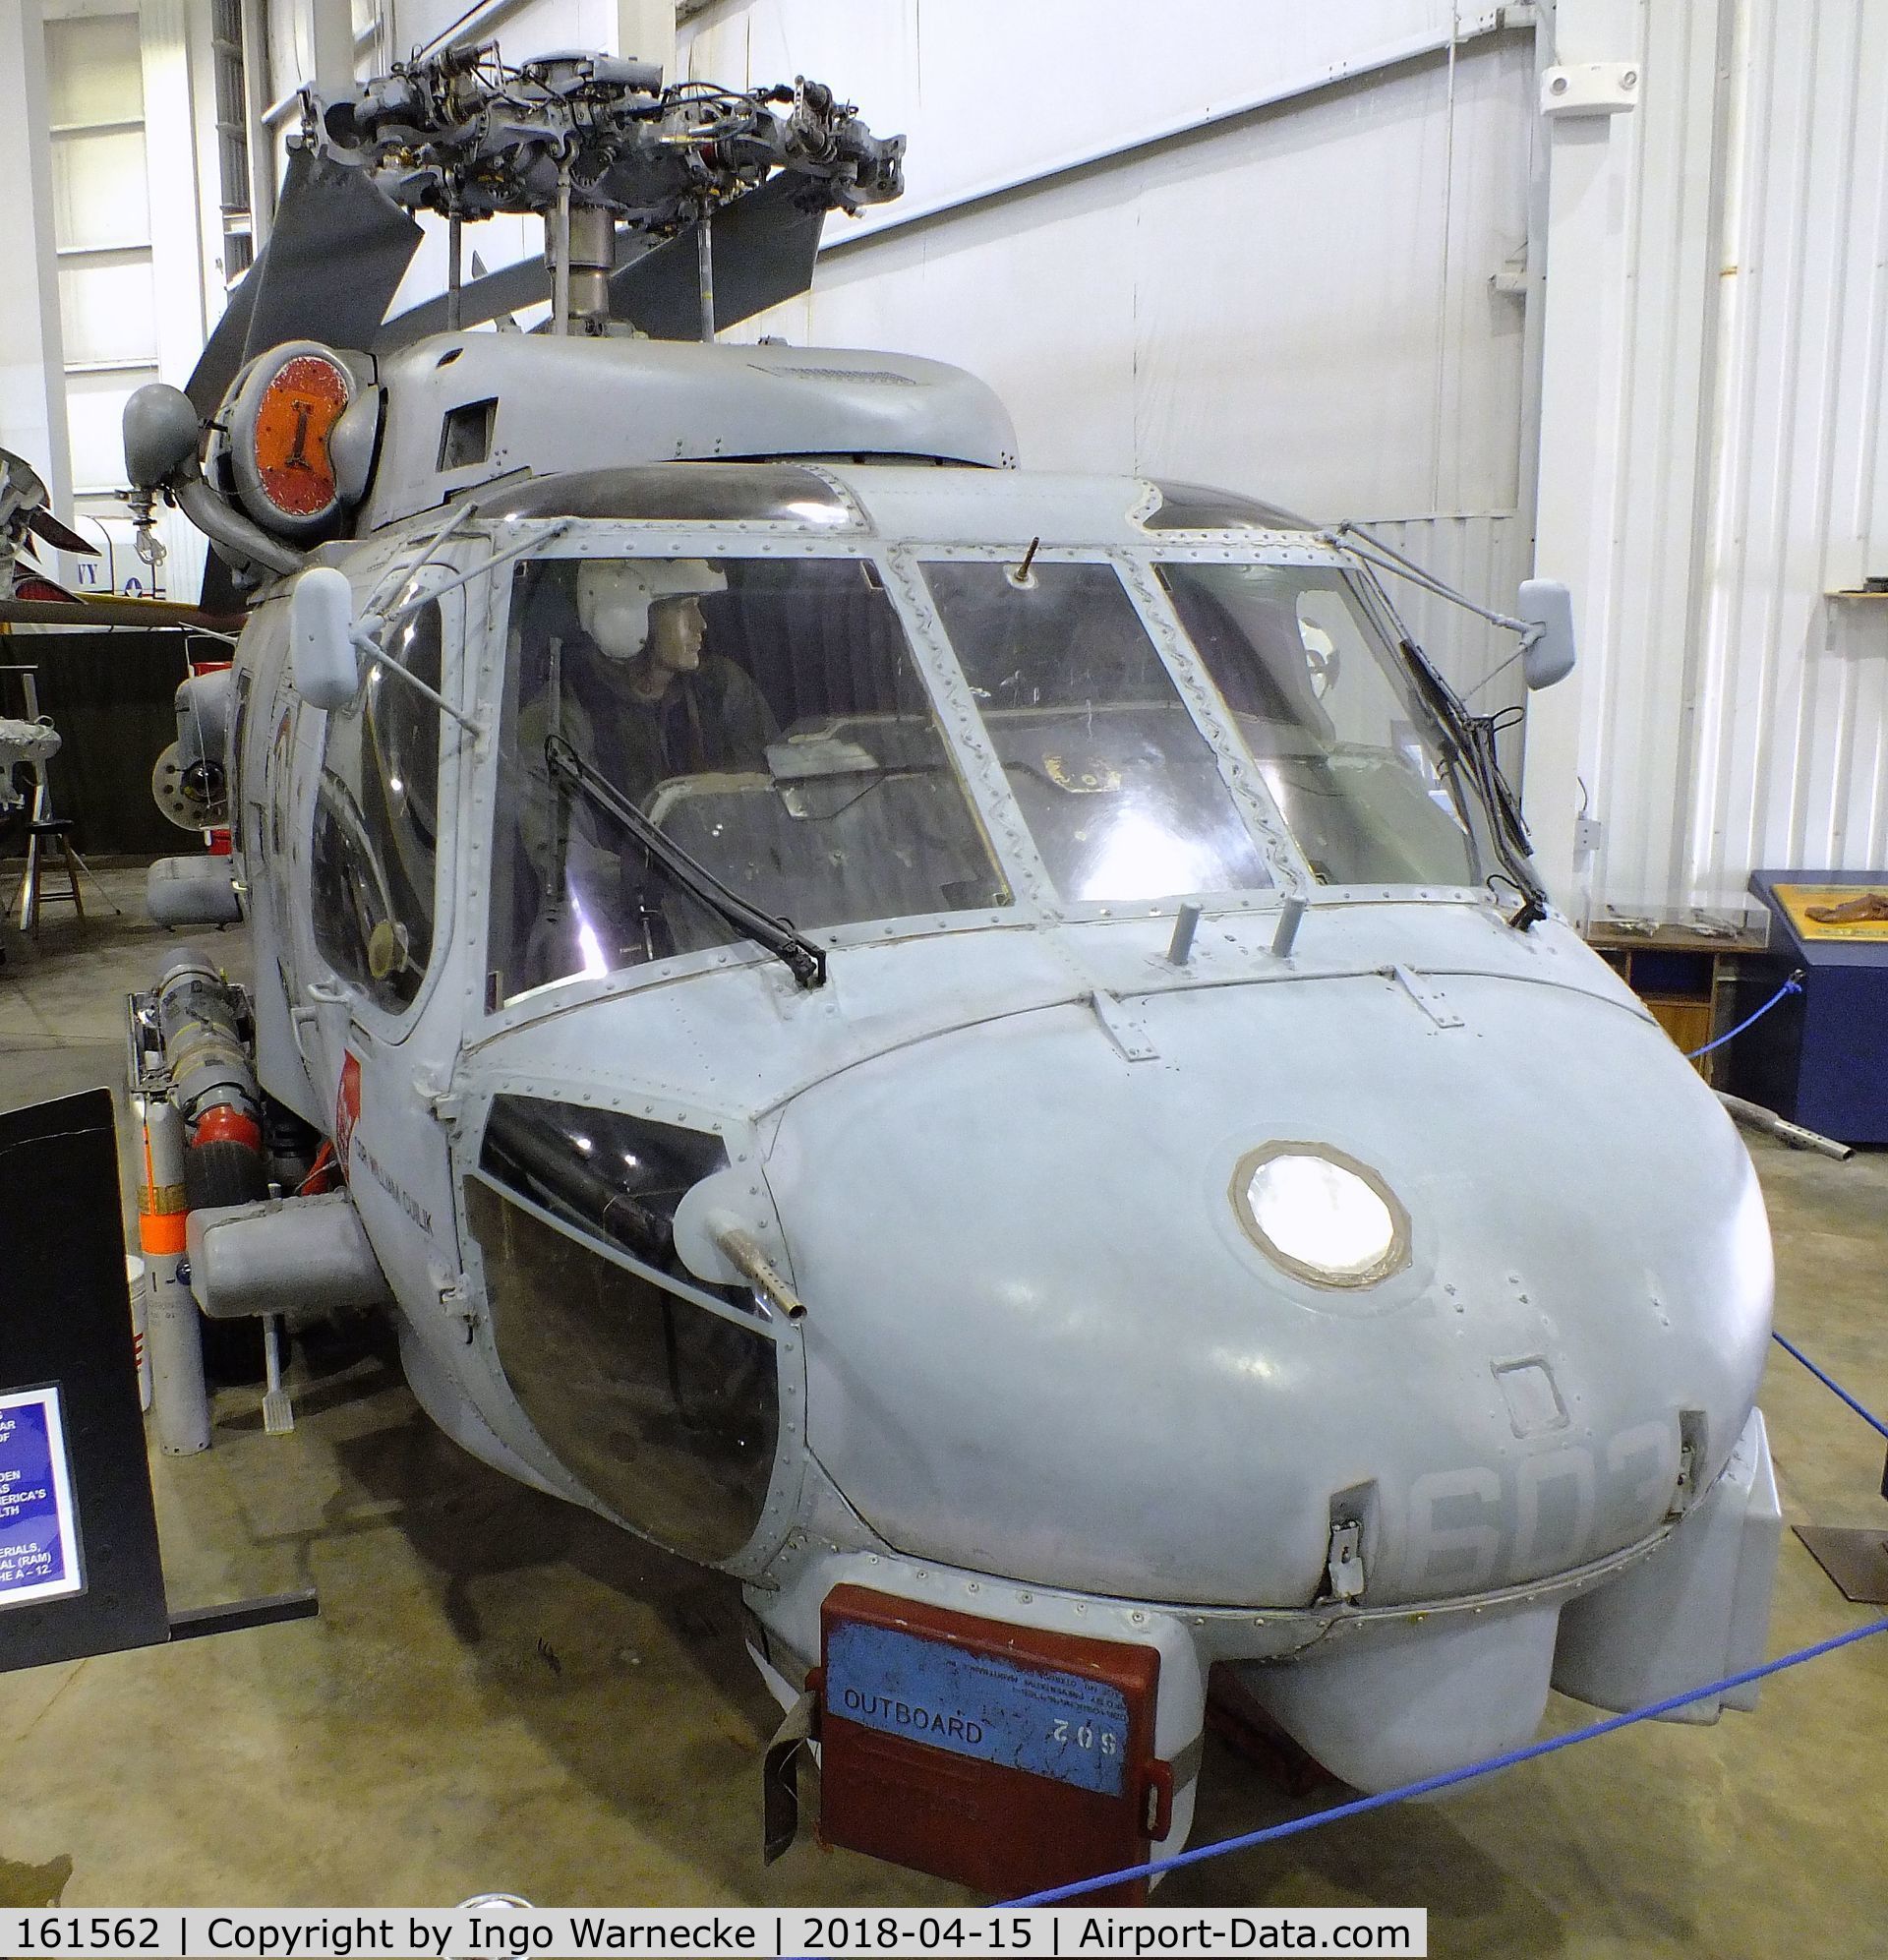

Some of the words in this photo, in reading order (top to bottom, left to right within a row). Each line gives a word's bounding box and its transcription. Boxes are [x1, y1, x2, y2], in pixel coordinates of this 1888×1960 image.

[0, 1489, 46, 1506] ERICA'S
[18, 1552, 51, 1569] (RAM)
[16, 1570, 25, 1579] A
[845, 1689, 983, 1745] OUTBOARD
